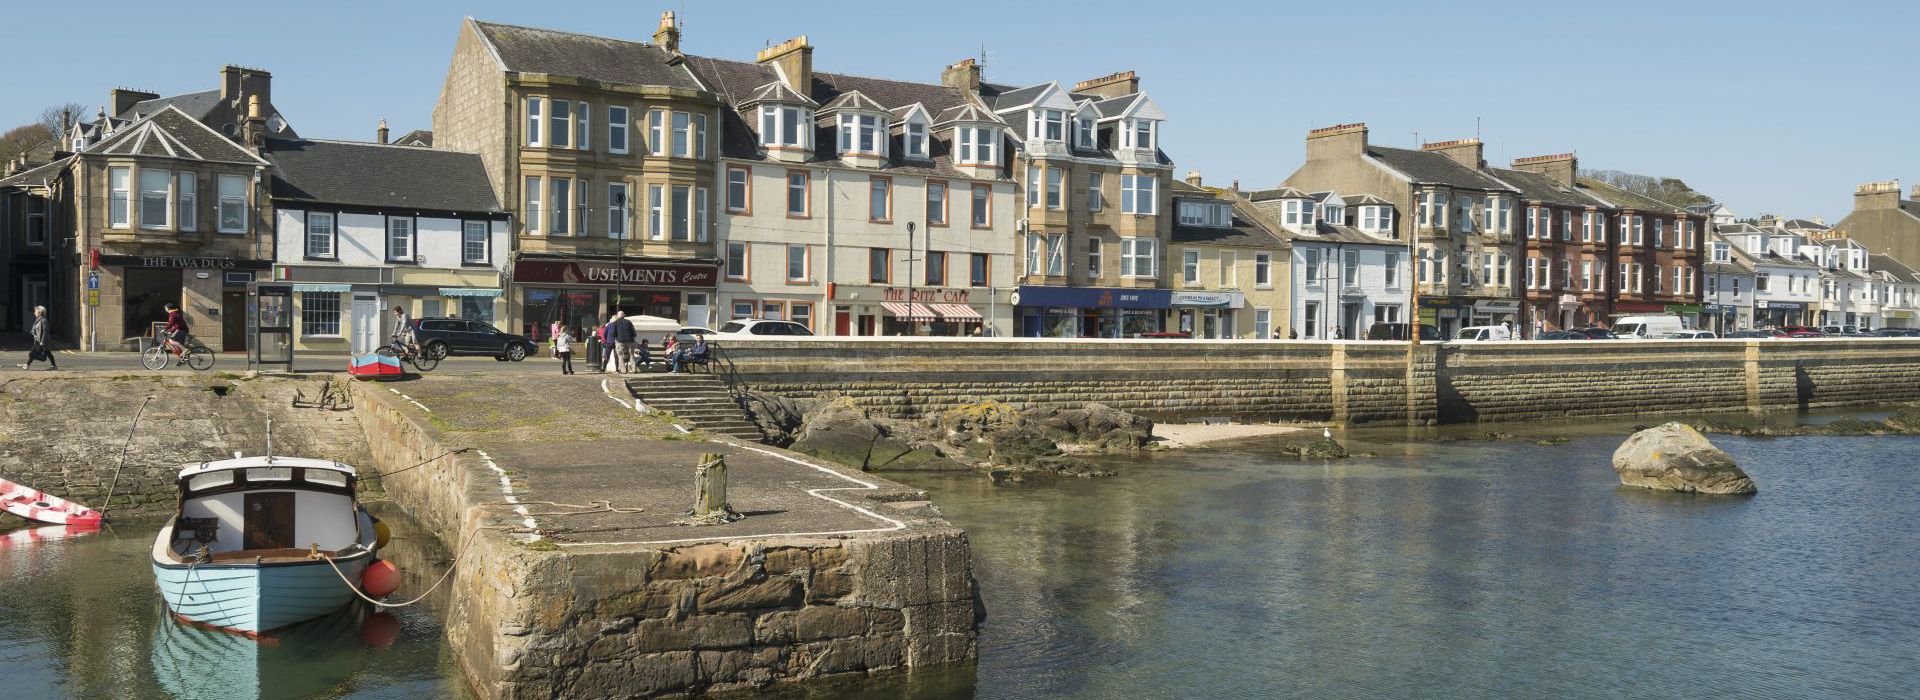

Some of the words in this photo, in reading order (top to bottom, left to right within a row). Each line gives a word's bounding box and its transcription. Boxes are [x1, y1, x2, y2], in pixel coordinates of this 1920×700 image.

[143, 257, 167, 267] THE
[170, 258, 198, 269] TWA
[201, 259, 235, 270] DUGS
[682, 271, 708, 283] Centre
[884, 288, 904, 300] THE
[911, 289, 936, 302] RITZ
